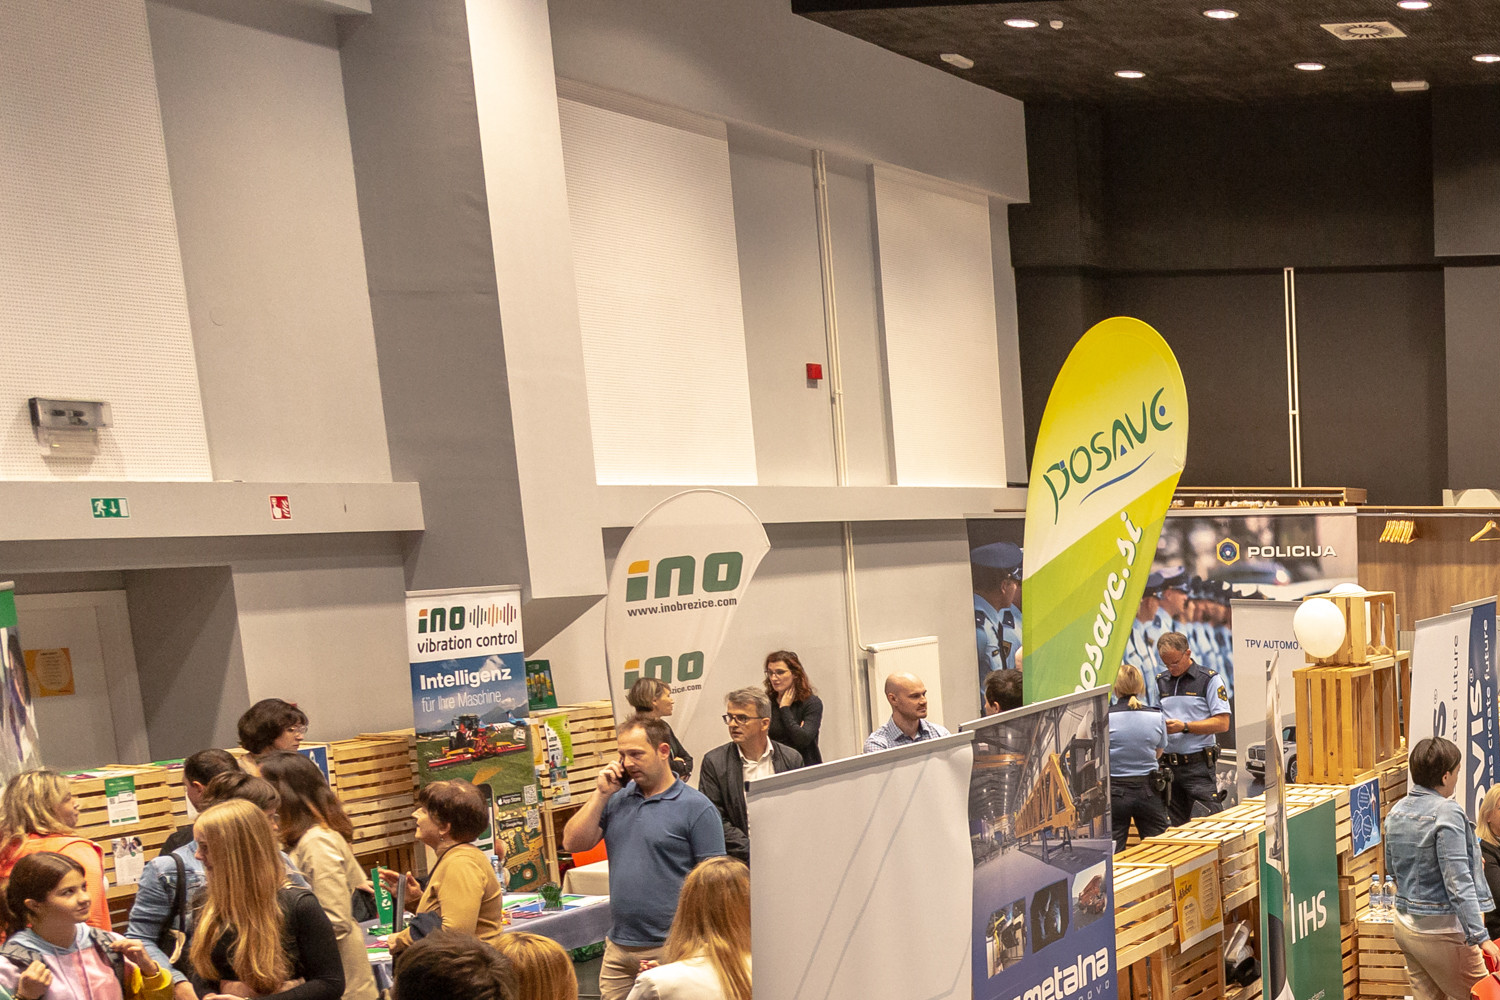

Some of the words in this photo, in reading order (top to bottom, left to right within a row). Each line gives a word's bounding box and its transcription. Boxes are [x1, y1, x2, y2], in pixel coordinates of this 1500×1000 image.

[1247, 545, 1337, 558] POLICIJA
[625, 551, 744, 602] ino
[627, 597, 738, 617] www.inobrezice.com
[418, 606, 466, 634] ino
[417, 635, 472, 653] vibration
[476, 630, 518, 648] control
[1245, 639, 1261, 648] TPV
[1263, 640, 1303, 650] AUTOMO
[1483, 619, 1491, 681] future
[420, 668, 512, 690] Intelligenz
[421, 696, 436, 712] für
[438, 694, 456, 711] Ihre
[457, 689, 502, 709] Maschine
[1485, 686, 1493, 749] create
[1298, 890, 1327, 940] IHS
